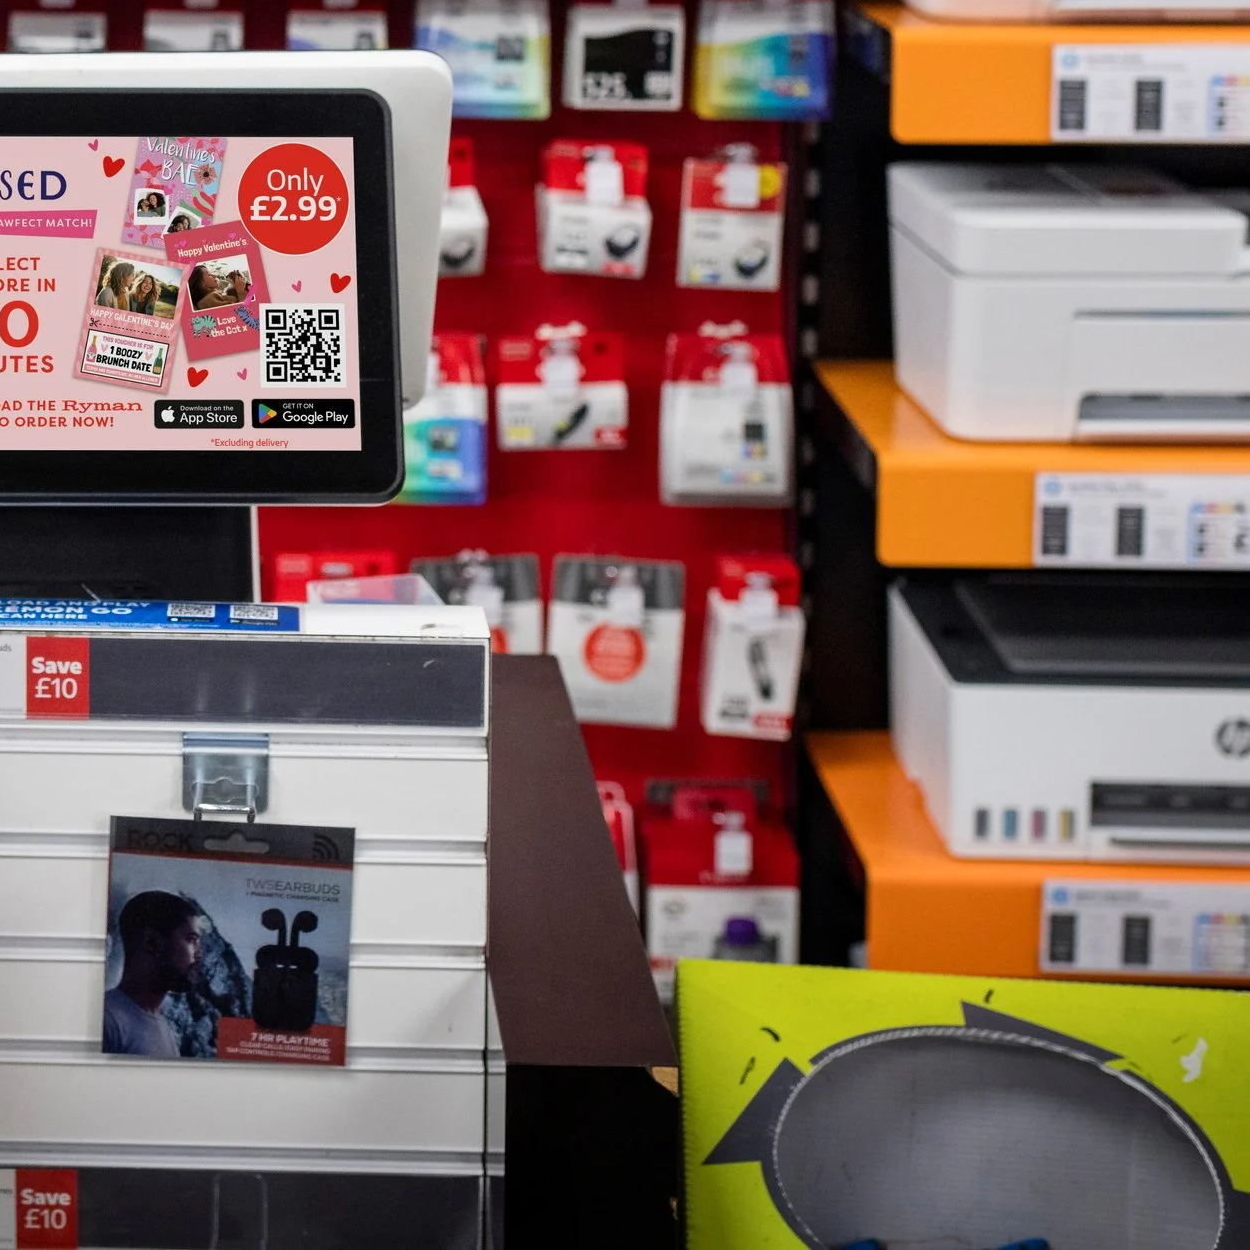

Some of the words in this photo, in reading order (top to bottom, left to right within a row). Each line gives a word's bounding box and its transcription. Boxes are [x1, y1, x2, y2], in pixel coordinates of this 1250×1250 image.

[267, 167, 325, 197] Only
[45, 218, 93, 228] MATCH!
[177, 246, 203, 258] Happy
[203, 237, 248, 254] Valentine's
[37, 278, 56, 292] IN
[90, 308, 113, 319] HAPPY
[114, 313, 159, 328] GALENTINE'S
[160, 321, 175, 331] DAY
[217, 316, 237, 326] Love
[210, 328, 225, 338] the
[226, 325, 241, 335] Cat
[102, 335, 114, 343] THIS
[114, 337, 137, 348] VOUCHER
[143, 342, 154, 350] FOR
[110, 345, 115, 355] 1
[116, 346, 143, 359] BOOZY
[96, 354, 130, 369] BRUNCH
[131, 360, 152, 373] DATE
[27, 400, 56, 411] THE
[62, 400, 143, 414] Ryman
[15, 416, 68, 428] ORDER
[72, 416, 114, 428] NOW!
[180, 413, 204, 425] App
[206, 412, 238, 423] Store
[282, 411, 324, 425] Google
[326, 411, 349, 425] Play
[256, 438, 288, 449] delivery
[91, 606, 133, 615] GO
[31, 656, 83, 675] Save
[34, 677, 78, 699] £10
[251, 1032, 258, 1041] 7
[258, 1033, 275, 1043] HR
[276, 1034, 331, 1047] PLAYTIME
[20, 1188, 72, 1206] Save
[24, 1208, 68, 1229] £10
